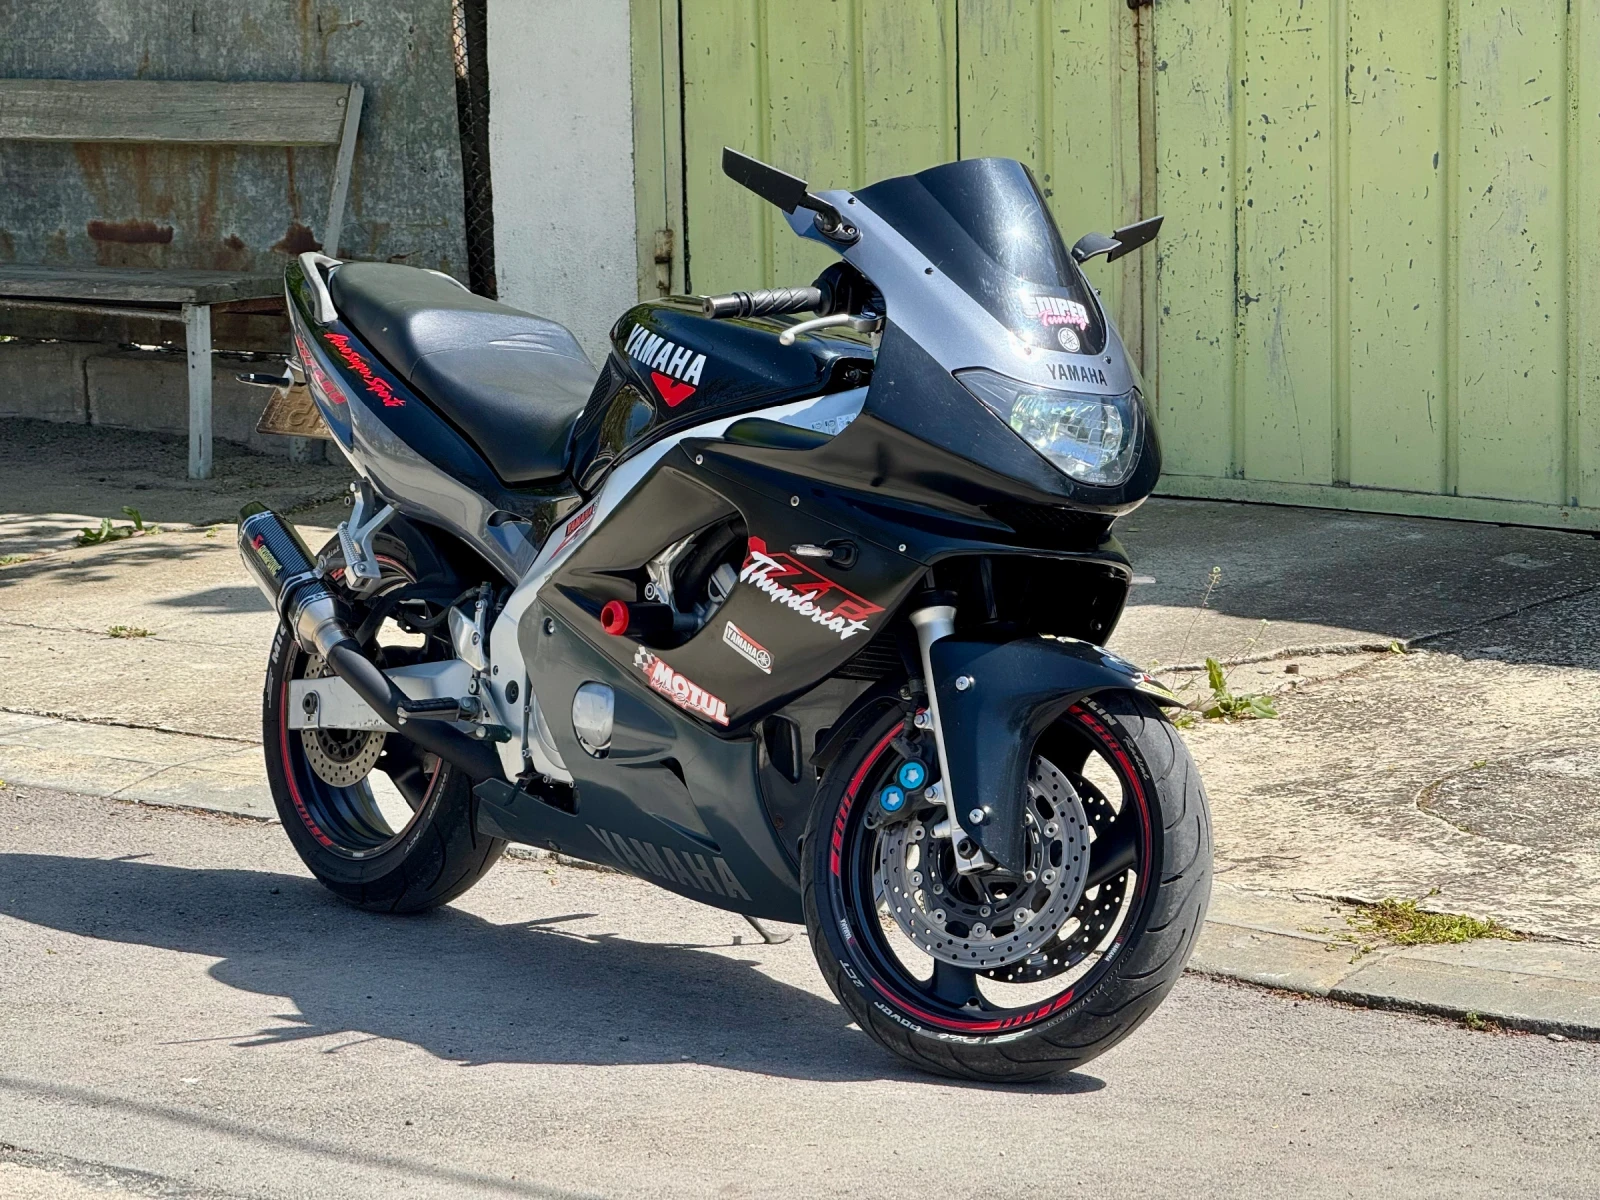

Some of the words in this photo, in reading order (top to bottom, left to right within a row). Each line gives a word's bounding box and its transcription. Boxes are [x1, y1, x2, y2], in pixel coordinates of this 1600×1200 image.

[1038, 308, 1087, 331] Tuning
[624, 323, 707, 386] YAMAHA
[1046, 363, 1108, 387] YAMAHA
[740, 551, 870, 640] Thundercat
[726, 627, 758, 659] YAMAHA
[652, 660, 730, 725] MOTUL
[585, 823, 753, 901] YAMAHA
[839, 959, 866, 988] 2CT
